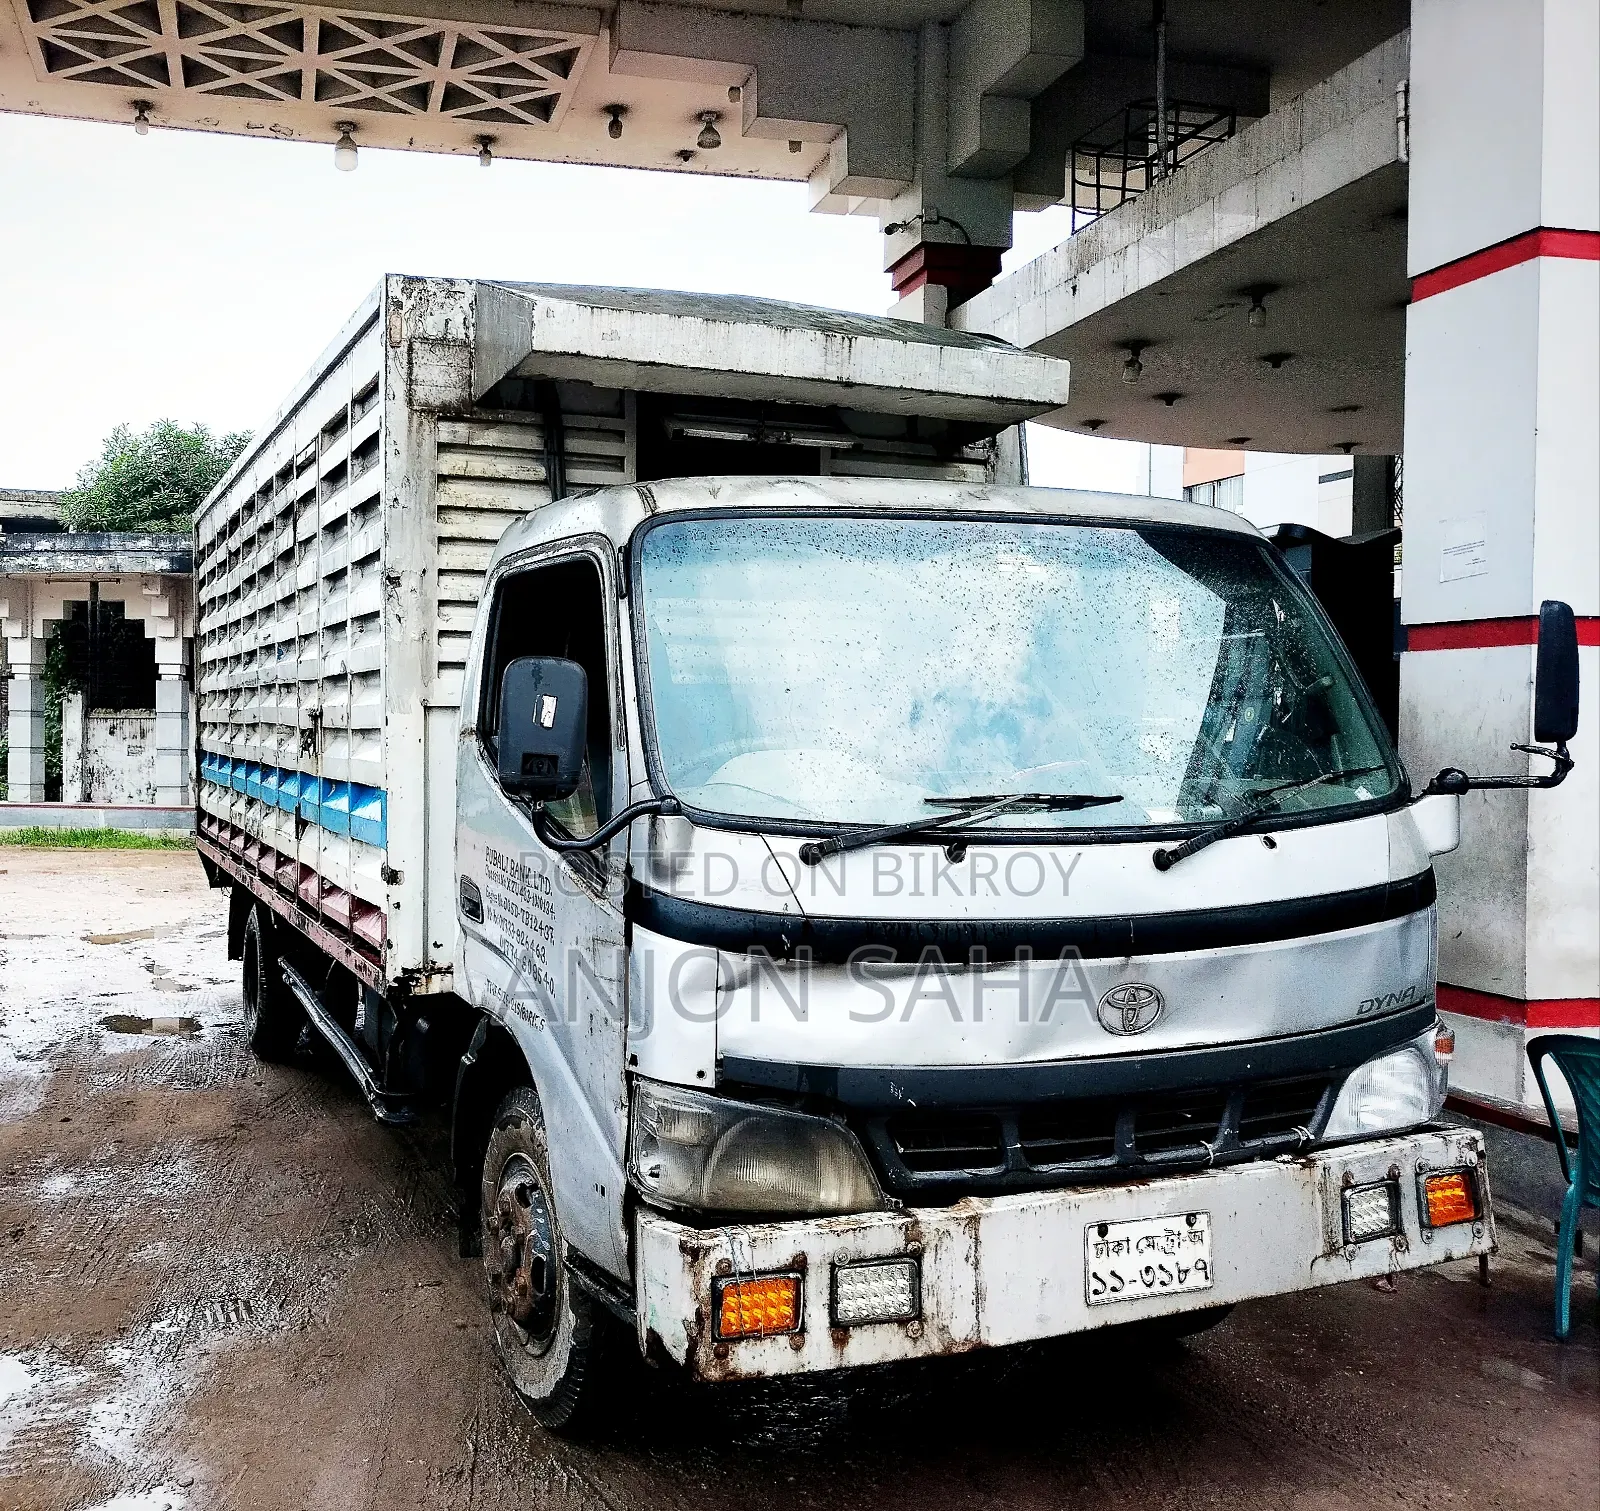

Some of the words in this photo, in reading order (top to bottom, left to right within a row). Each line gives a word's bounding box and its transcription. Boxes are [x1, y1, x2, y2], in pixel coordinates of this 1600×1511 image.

[485, 845, 509, 873] PUBALI
[1356, 985, 1416, 1015] DYNA
[1092, 1237, 1131, 1258] ঢাকা
[1092, 1258, 1210, 1296] ১১-৩১৮৭
